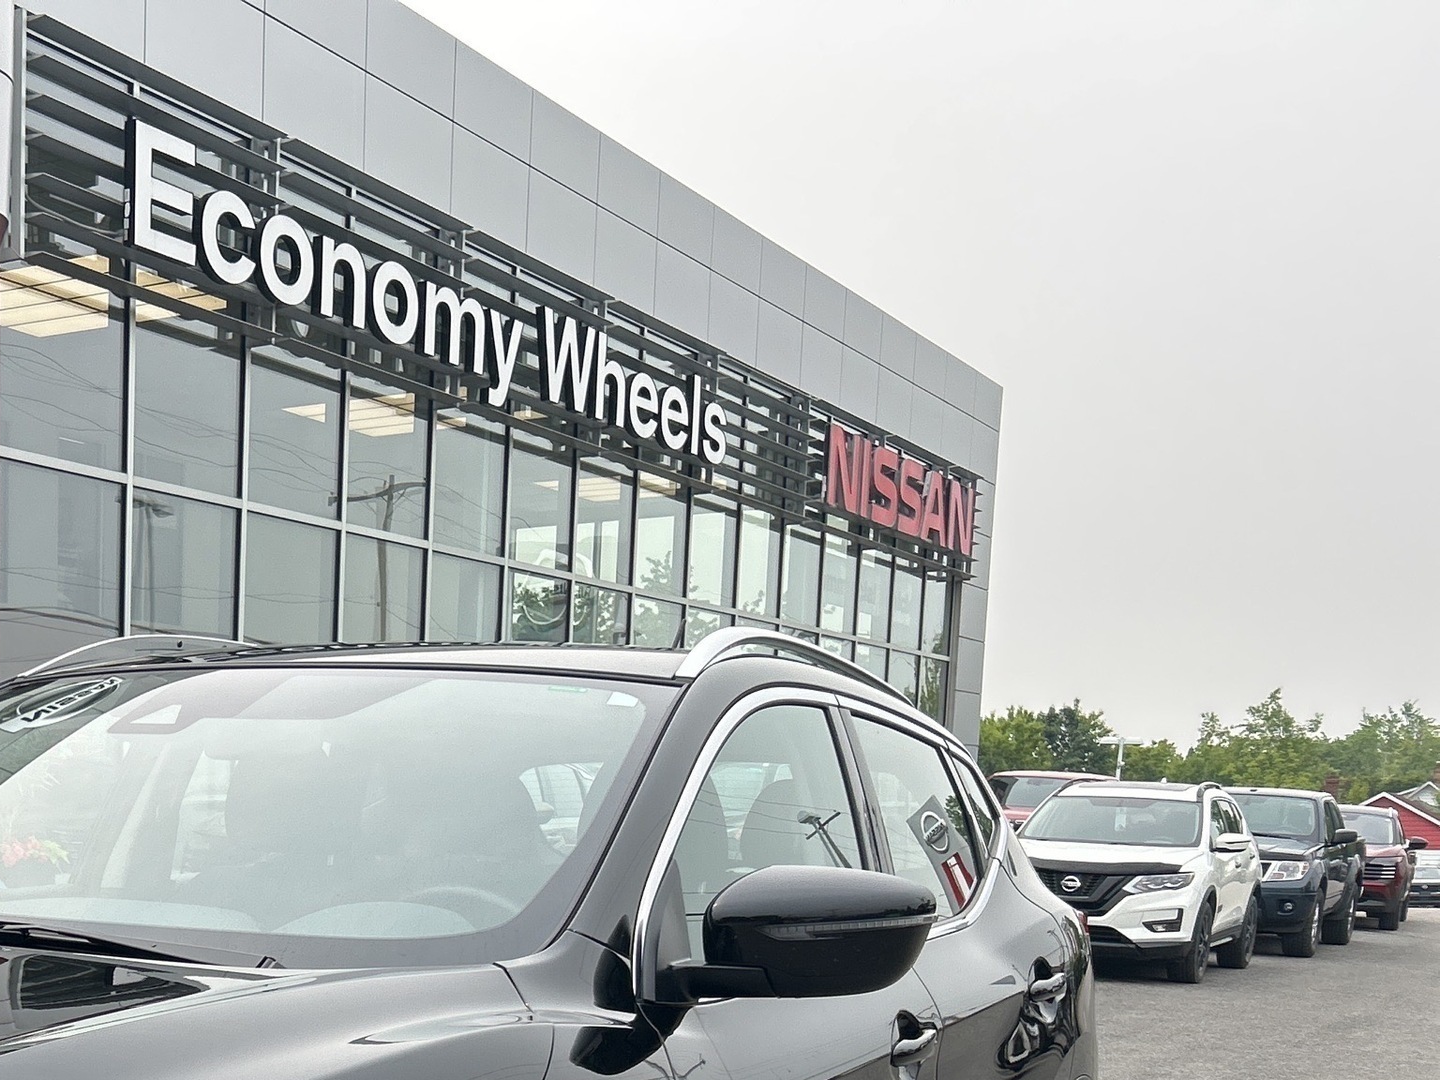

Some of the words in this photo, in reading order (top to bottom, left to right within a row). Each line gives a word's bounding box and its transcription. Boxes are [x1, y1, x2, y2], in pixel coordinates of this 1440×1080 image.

[128, 116, 524, 406] Economy
[537, 304, 727, 466] Wheels
[826, 424, 976, 556] NISSAN
